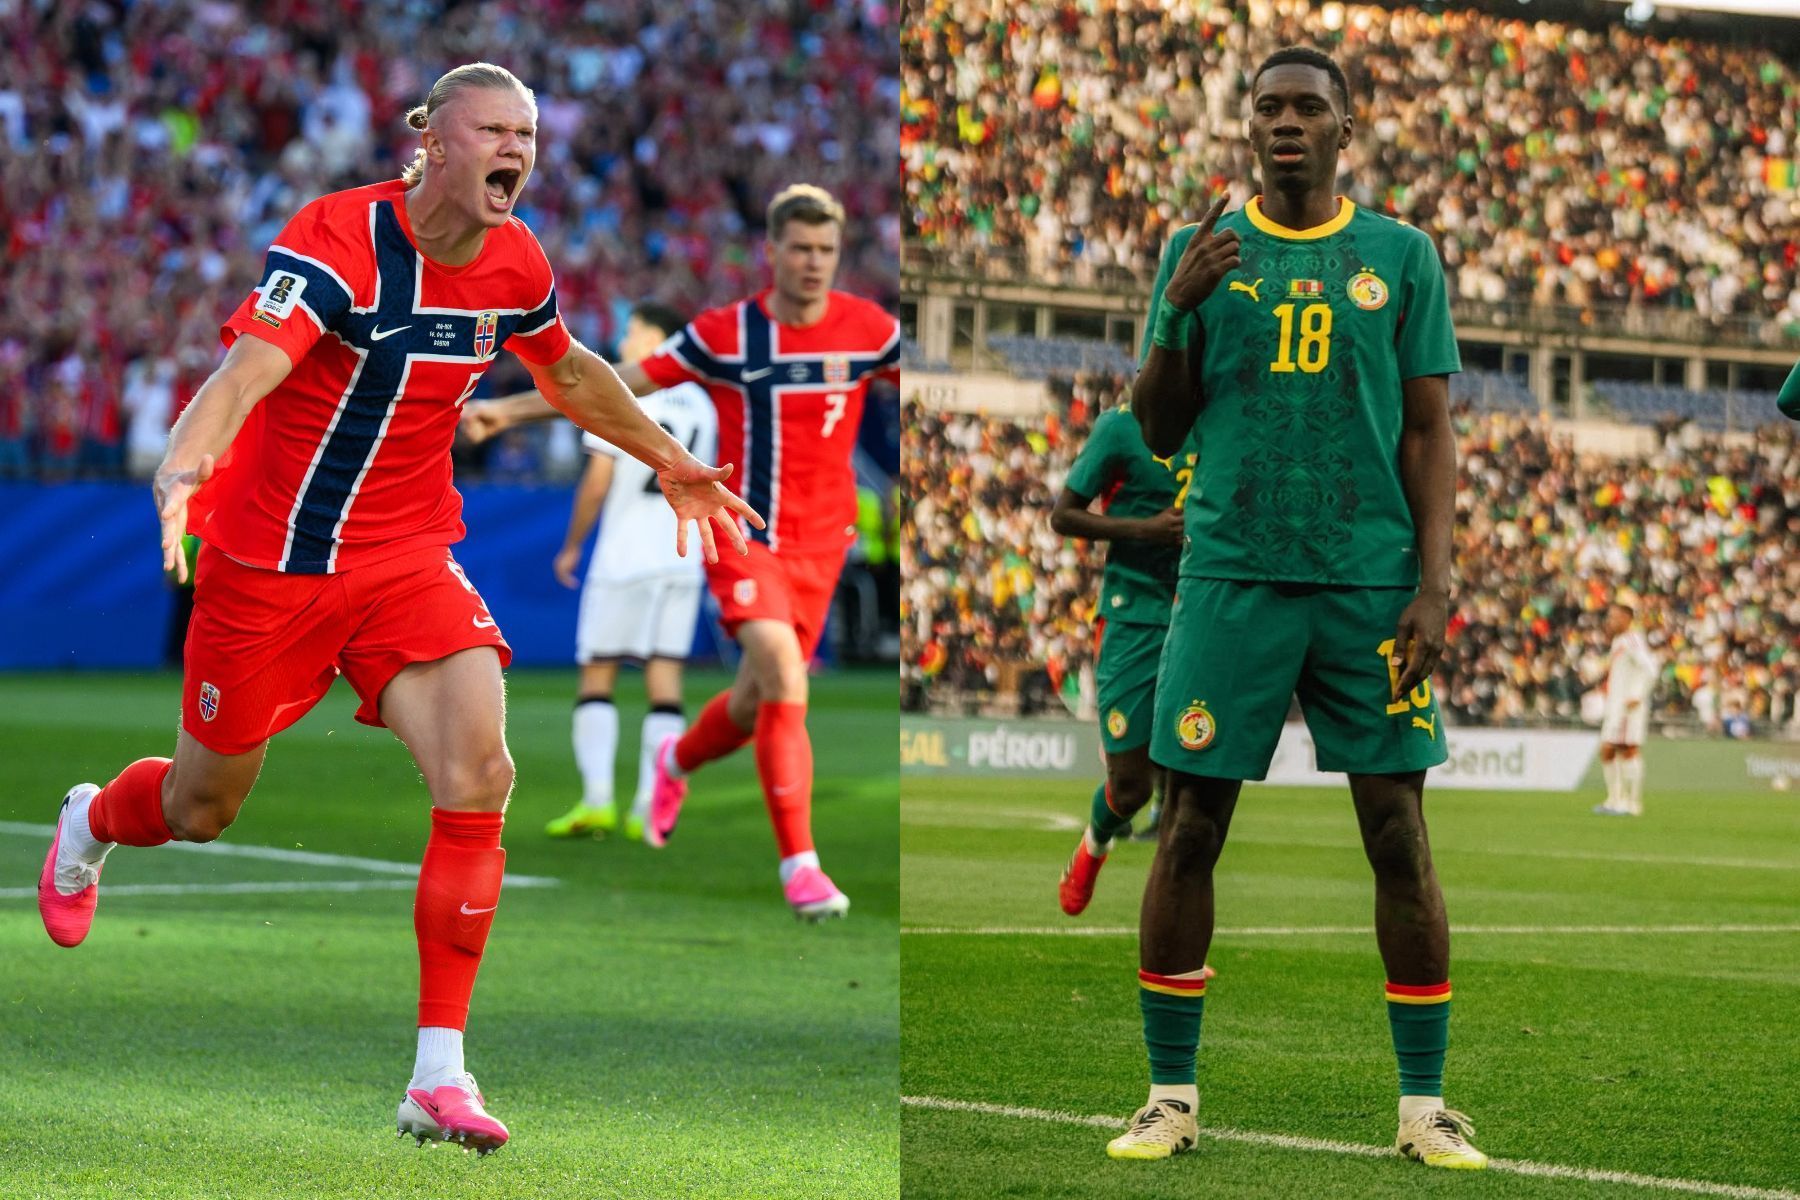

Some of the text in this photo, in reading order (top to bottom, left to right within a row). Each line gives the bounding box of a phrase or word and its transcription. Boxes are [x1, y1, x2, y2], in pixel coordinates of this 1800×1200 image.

[263, 303, 281, 313] 2026
[1270, 303, 1333, 373] 18
[821, 393, 847, 438] 7
[968, 723, 1078, 770] PÉROU
